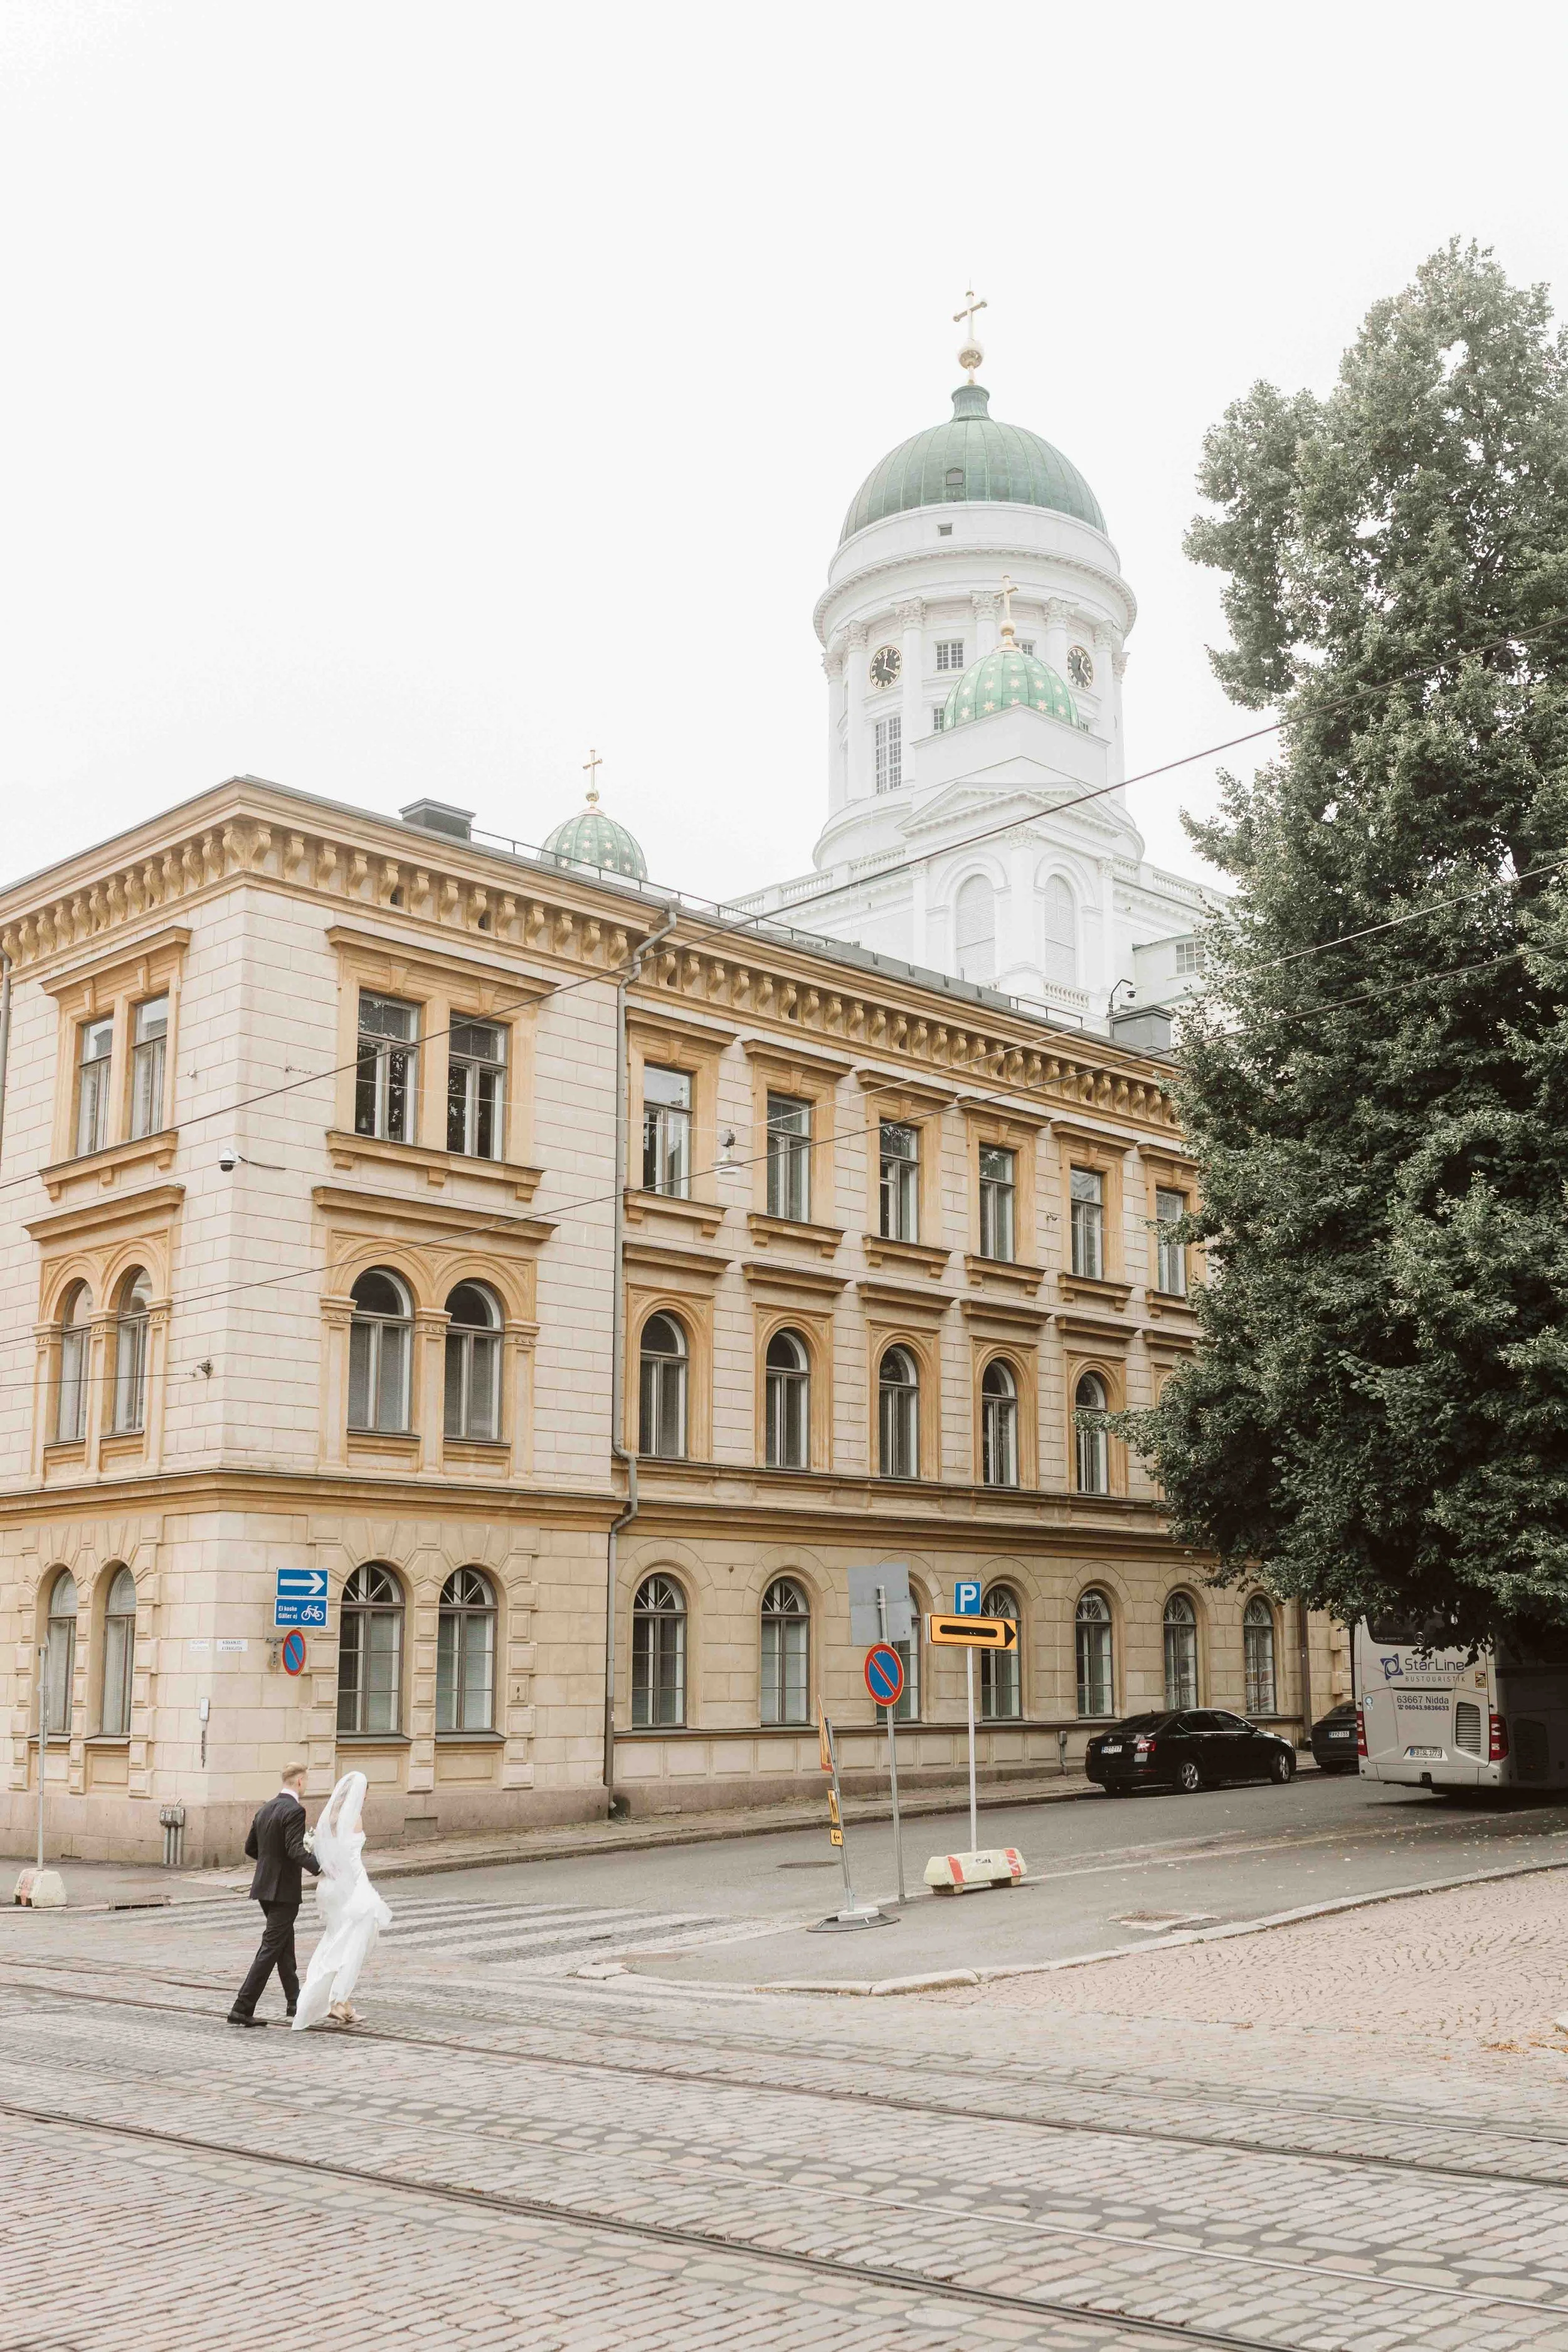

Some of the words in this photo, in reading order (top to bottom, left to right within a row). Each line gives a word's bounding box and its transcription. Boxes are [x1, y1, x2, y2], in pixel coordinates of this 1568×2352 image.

[960, 1584, 977, 1613] P
[1404, 1658, 1465, 1671] StarLine
[1397, 1695, 1423, 1703] 63667
[1426, 1695, 1449, 1704] Nidda
